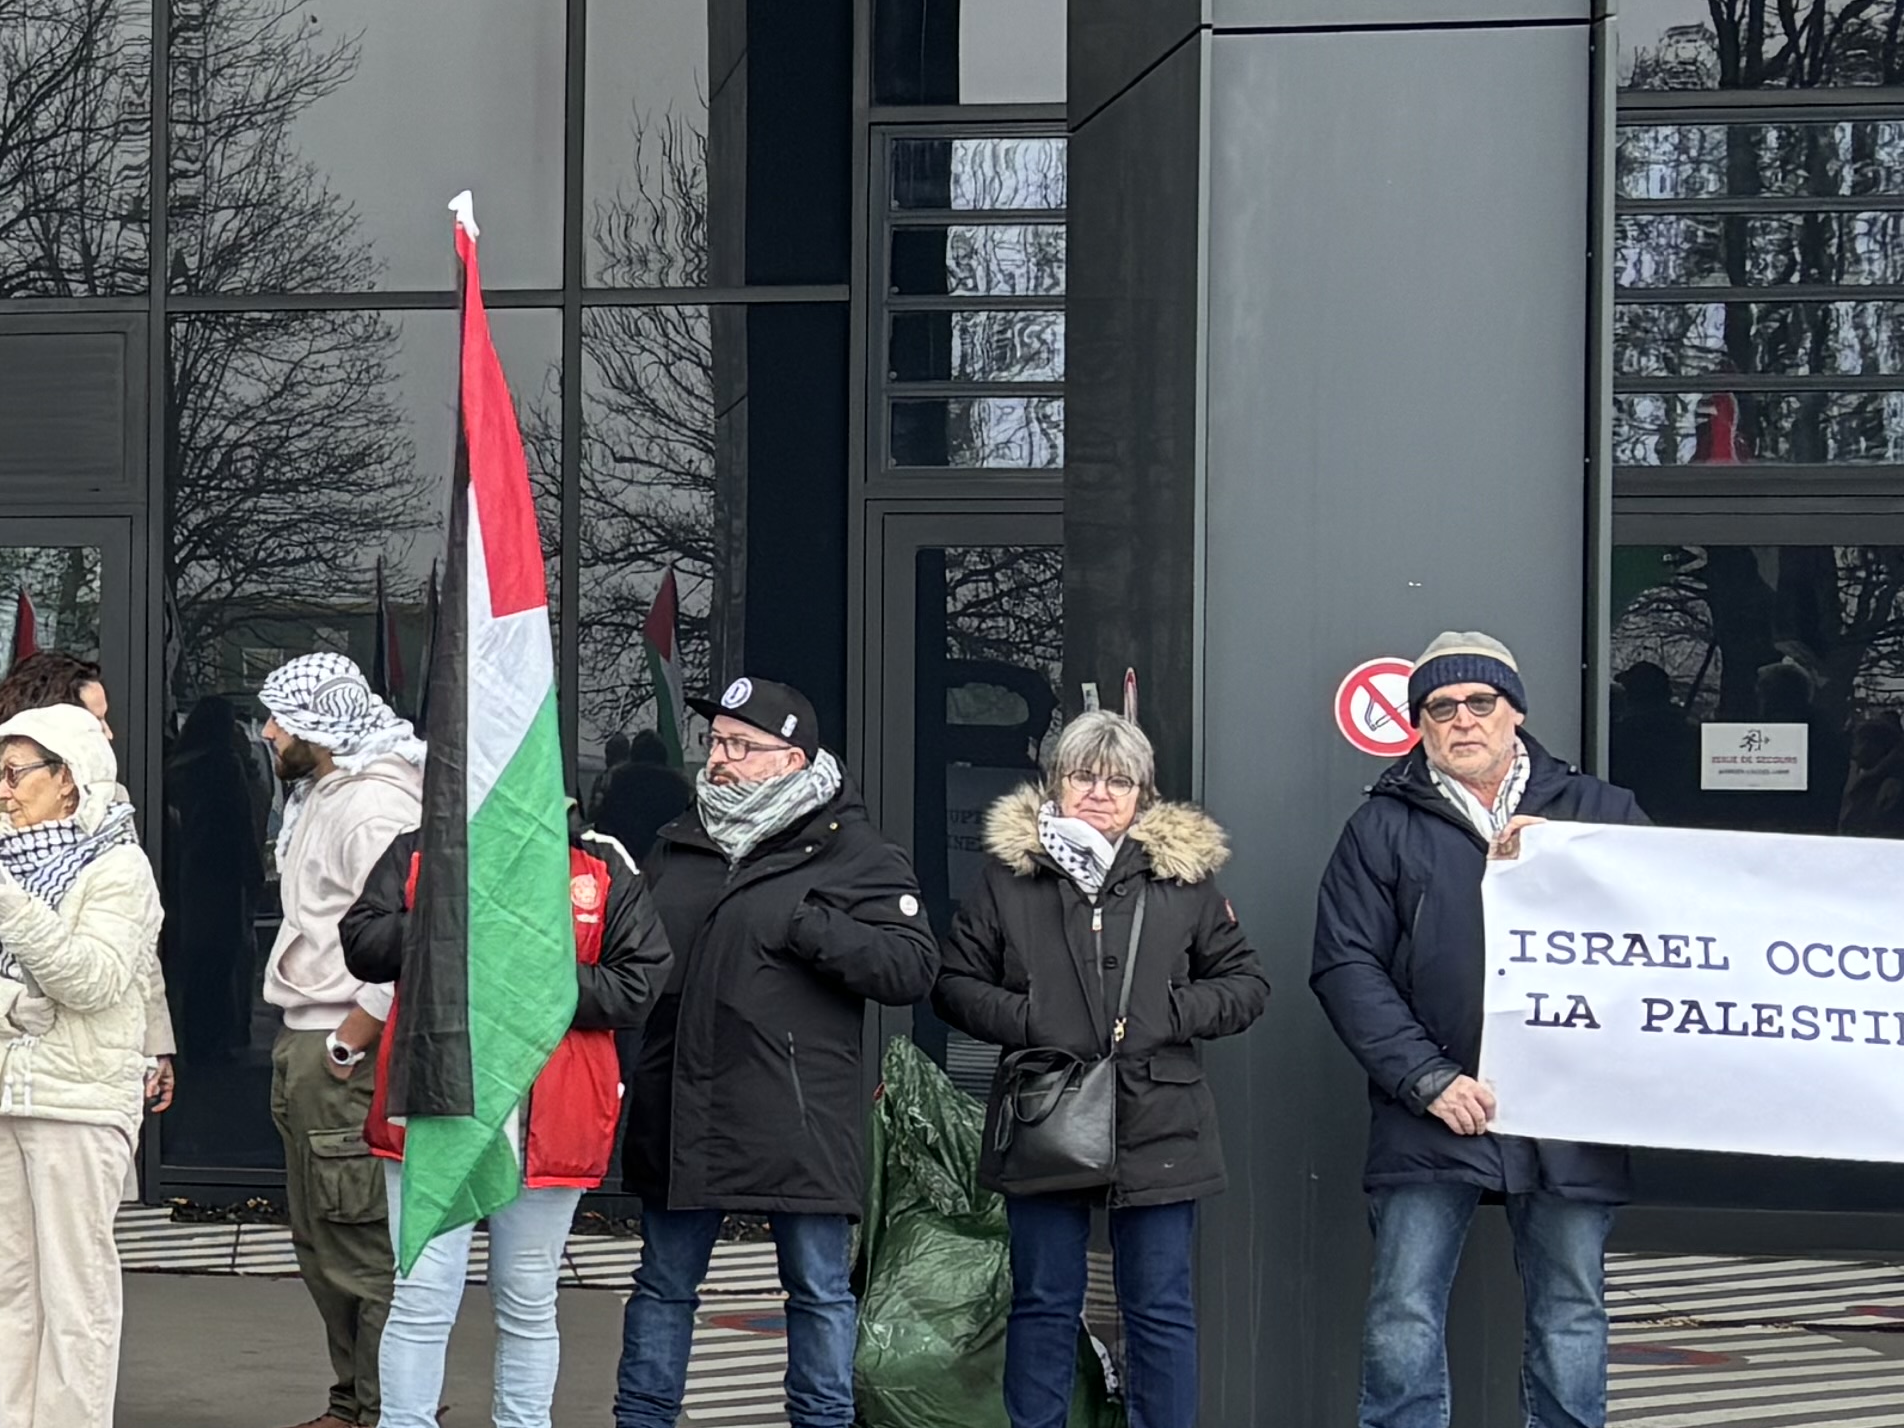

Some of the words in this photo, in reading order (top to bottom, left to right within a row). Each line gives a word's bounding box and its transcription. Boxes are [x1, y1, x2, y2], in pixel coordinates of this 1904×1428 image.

[1509, 929, 1730, 970] ISRAEL
[1766, 940, 1904, 983] OCCU
[1525, 992, 1602, 1029] LA
